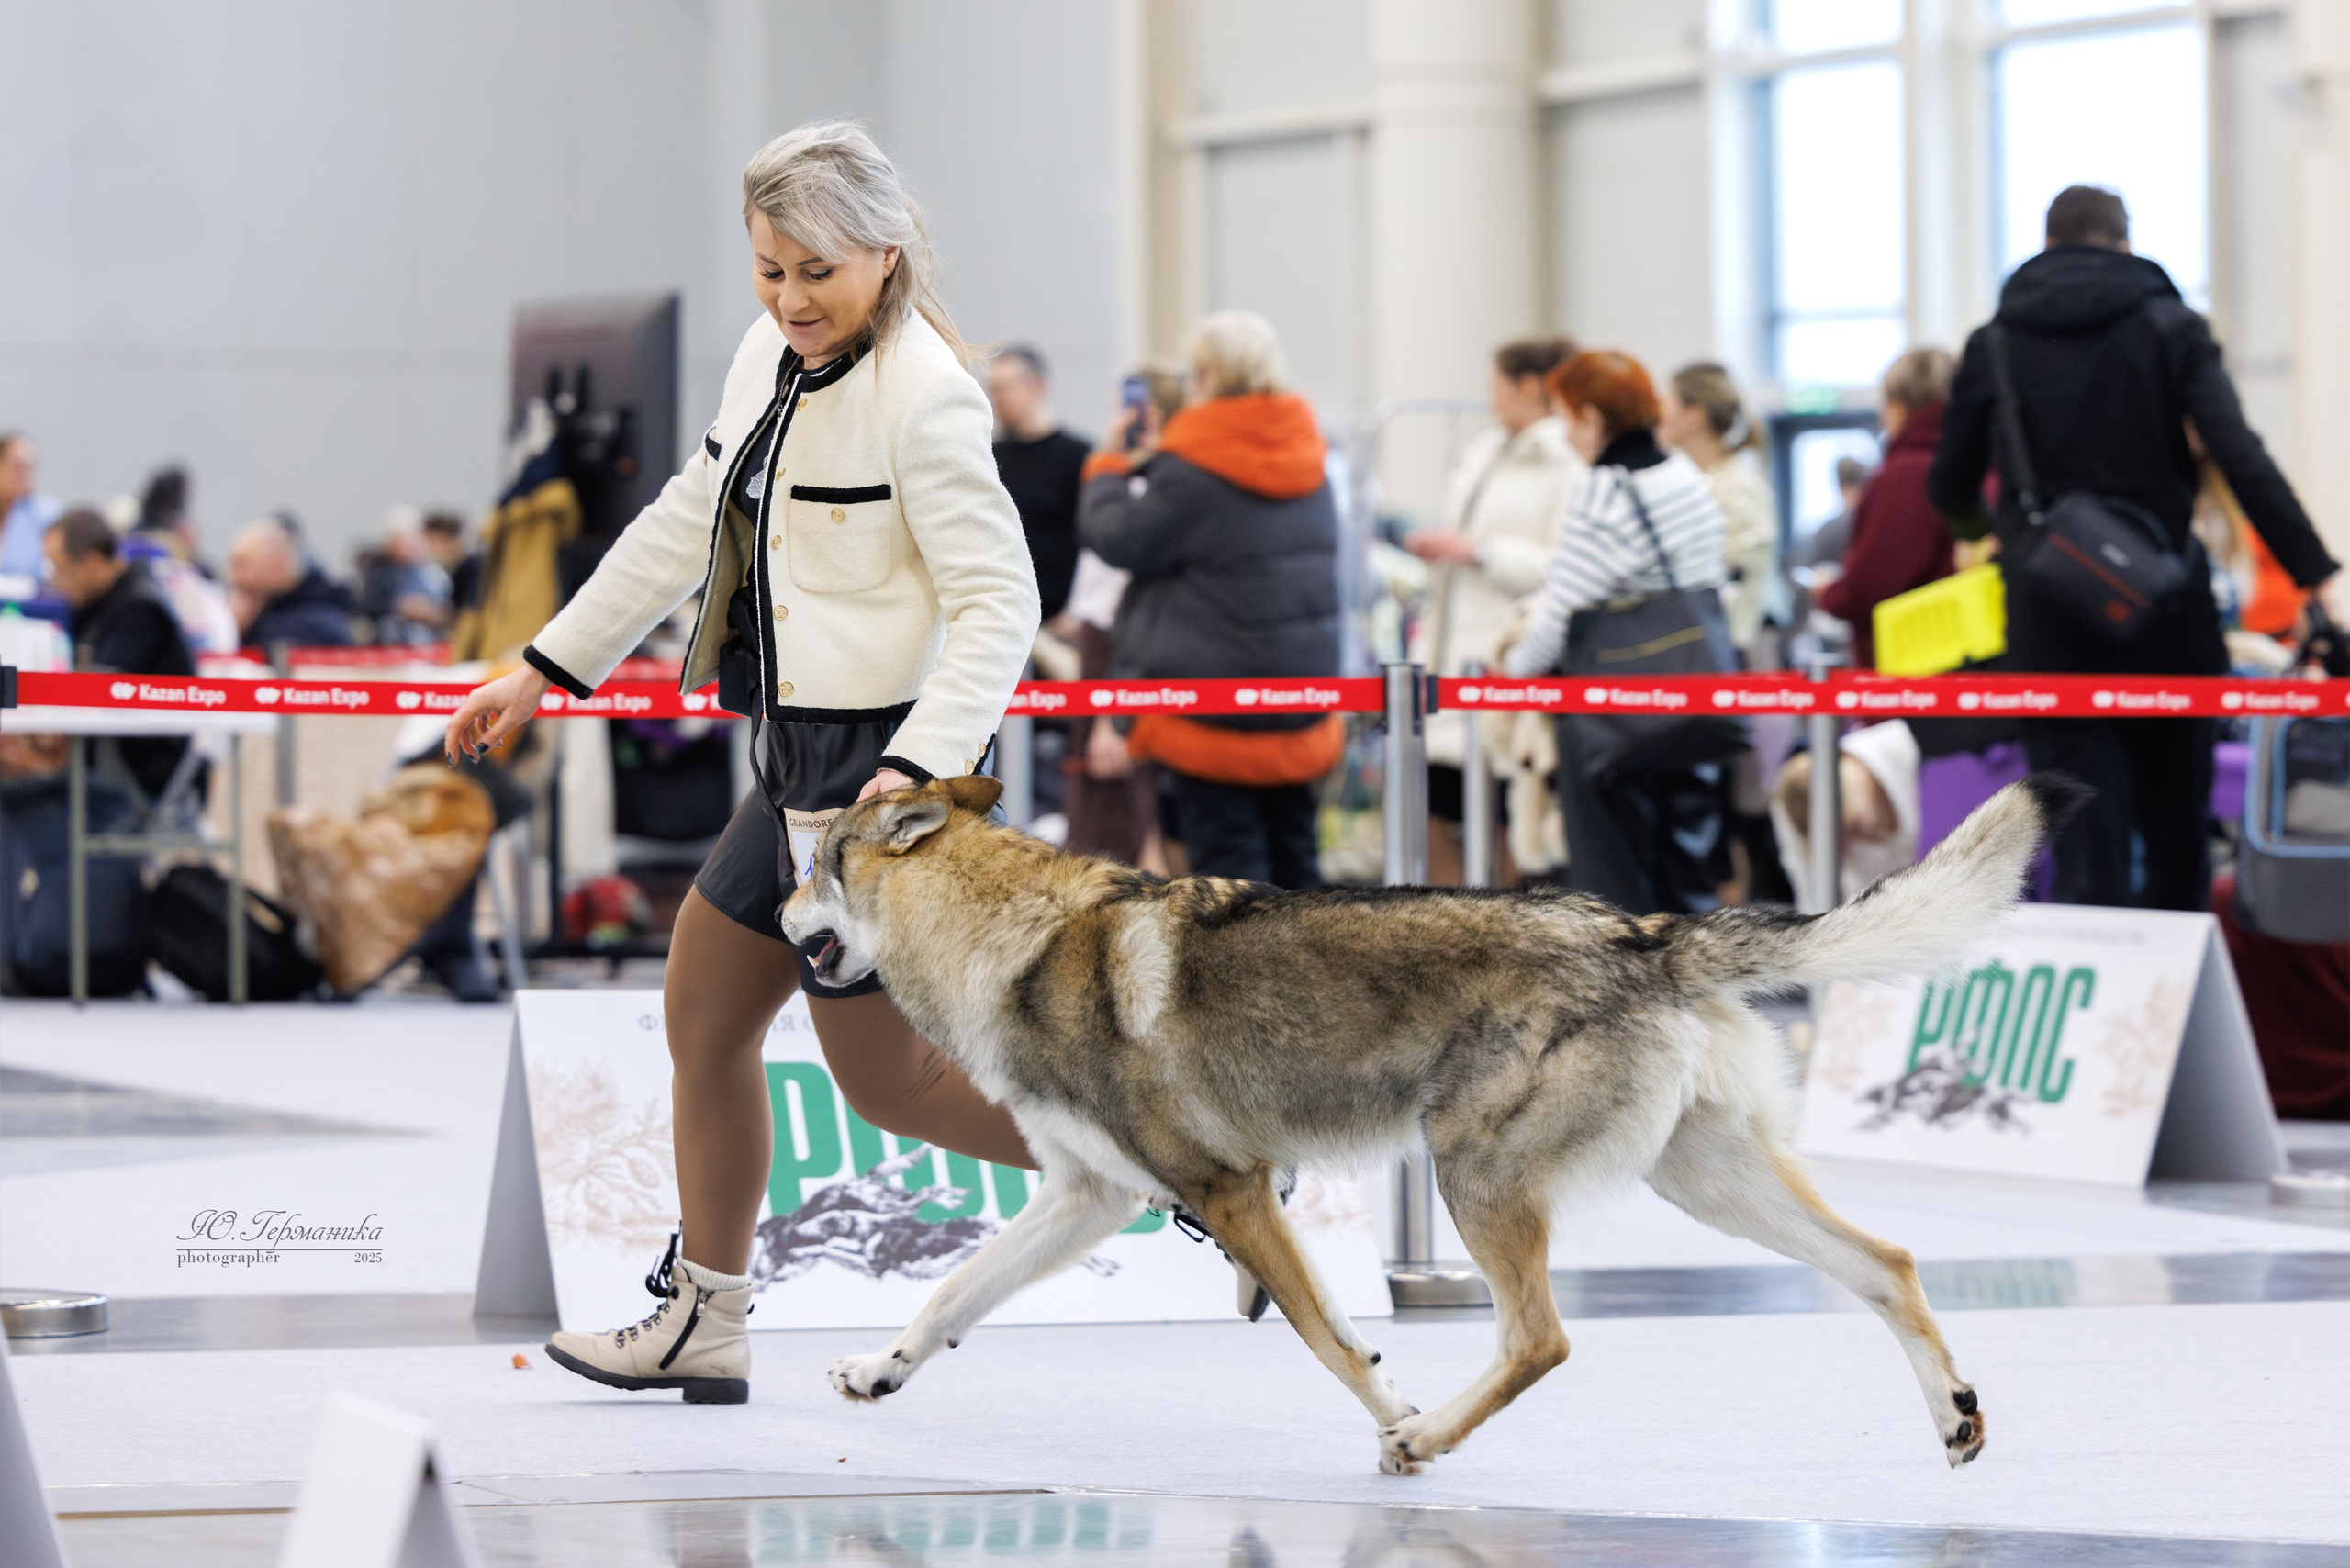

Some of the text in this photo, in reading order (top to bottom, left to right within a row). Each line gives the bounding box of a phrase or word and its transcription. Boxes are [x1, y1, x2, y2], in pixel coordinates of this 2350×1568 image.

[140, 683, 227, 708] Kazan Expo
[283, 687, 370, 709] Kazan Expo
[567, 692, 652, 713] Kazan Expo
[1029, 689, 1066, 711] Expo
[1115, 688, 1198, 708] Kazan Expo
[1260, 688, 1341, 707] Kazan Expo
[1483, 685, 1562, 706] Kazan Expo
[1608, 689, 1688, 709] Kazan Expo
[1736, 689, 1815, 709] Kazan Expo
